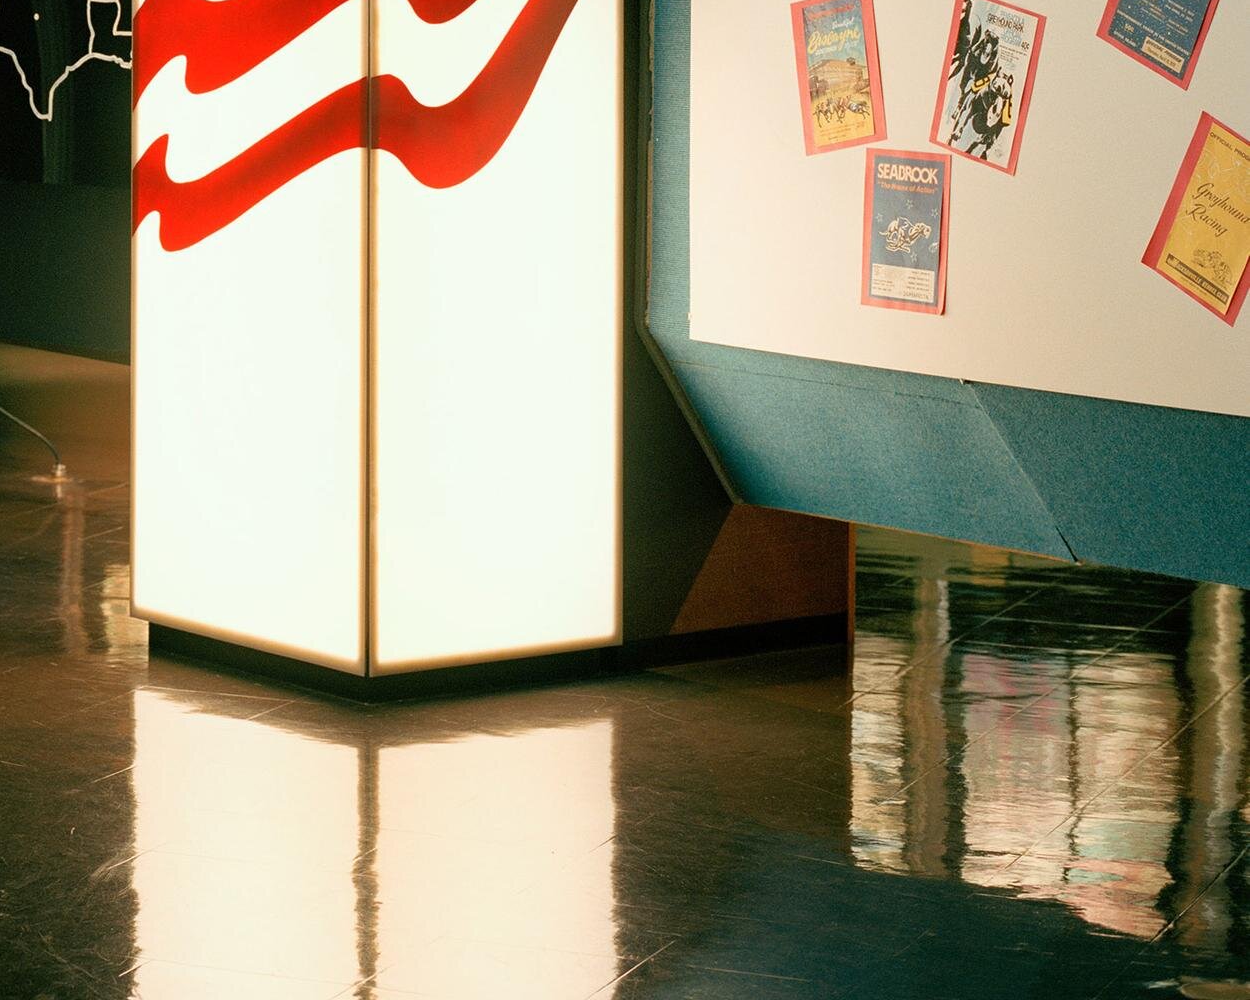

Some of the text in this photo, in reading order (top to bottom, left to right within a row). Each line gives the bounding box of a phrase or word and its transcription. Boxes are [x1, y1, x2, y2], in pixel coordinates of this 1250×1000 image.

[1210, 131, 1233, 150] OFFICIAL
[877, 163, 939, 185] SEABROOK
[1185, 203, 1228, 237] Racing
